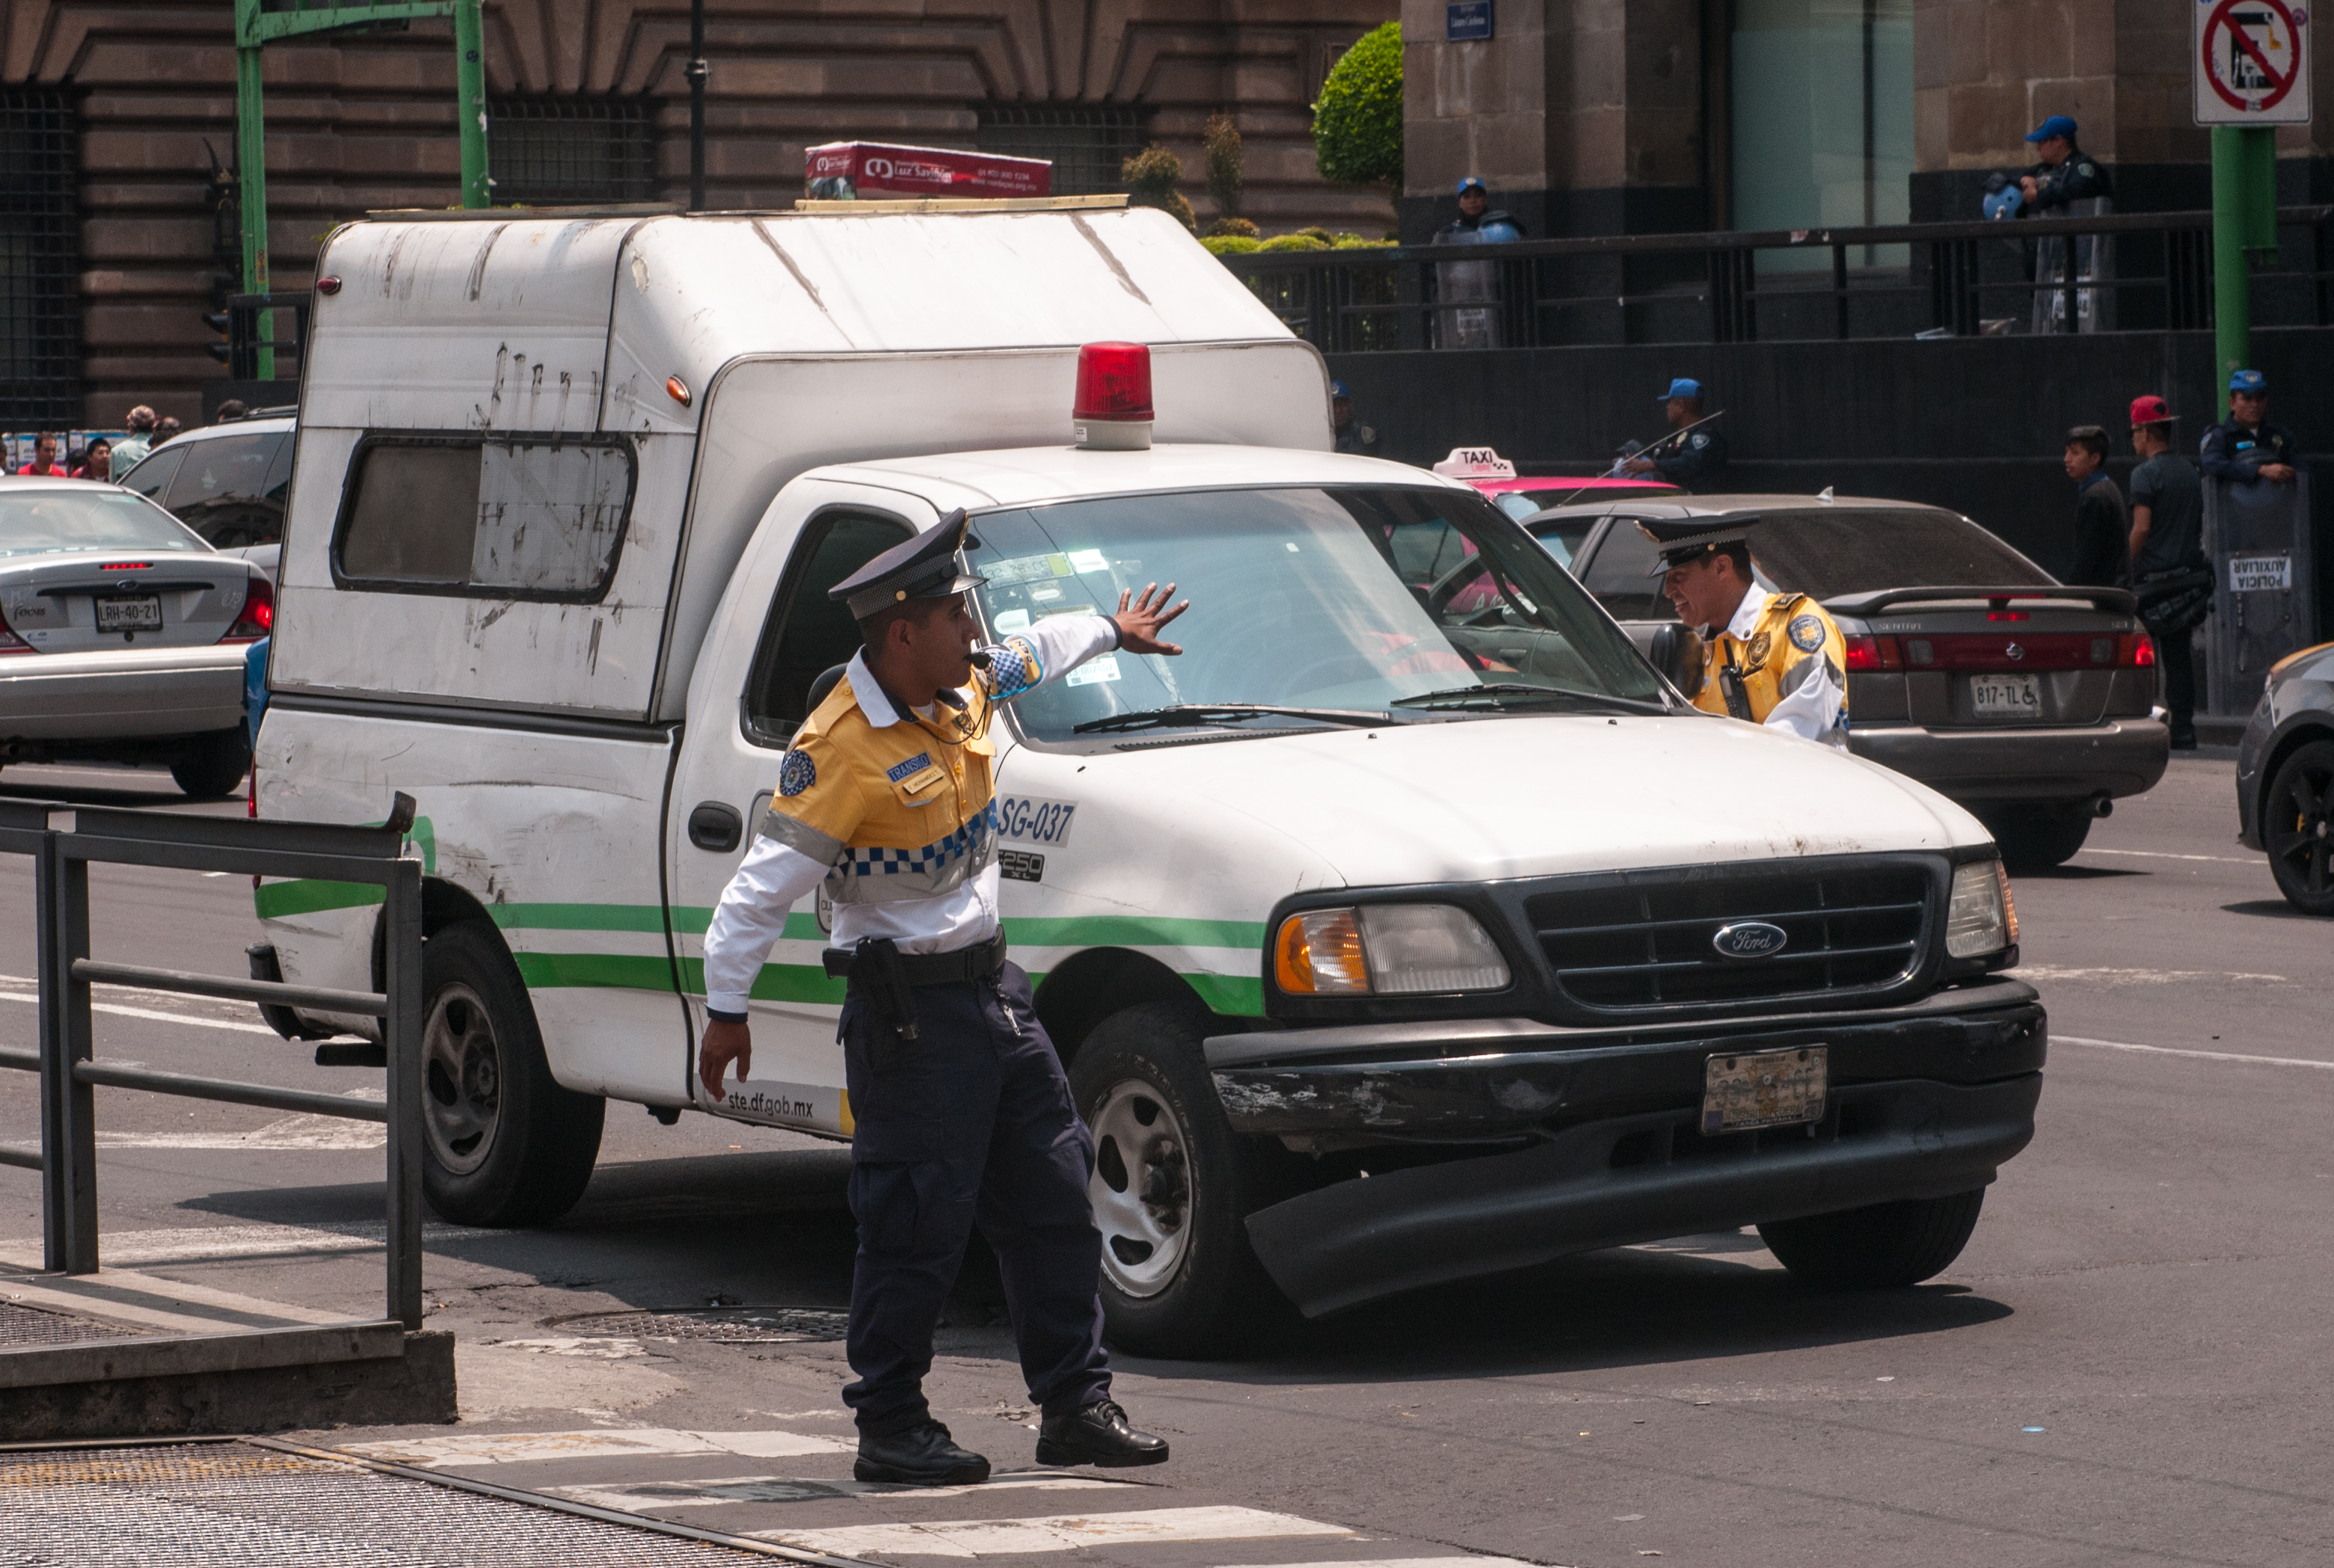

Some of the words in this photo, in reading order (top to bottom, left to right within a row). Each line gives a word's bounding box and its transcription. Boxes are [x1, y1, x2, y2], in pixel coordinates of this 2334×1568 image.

[1461, 451, 1493, 464] TAXI
[2233, 560, 2286, 574] AUXILIAR
[2238, 574, 2283, 588] POLICIA
[99, 604, 158, 621] LRH-40-21
[1977, 686, 2020, 704] 817-TL
[998, 797, 1075, 843] SG-037
[1732, 929, 1771, 950] Ford
